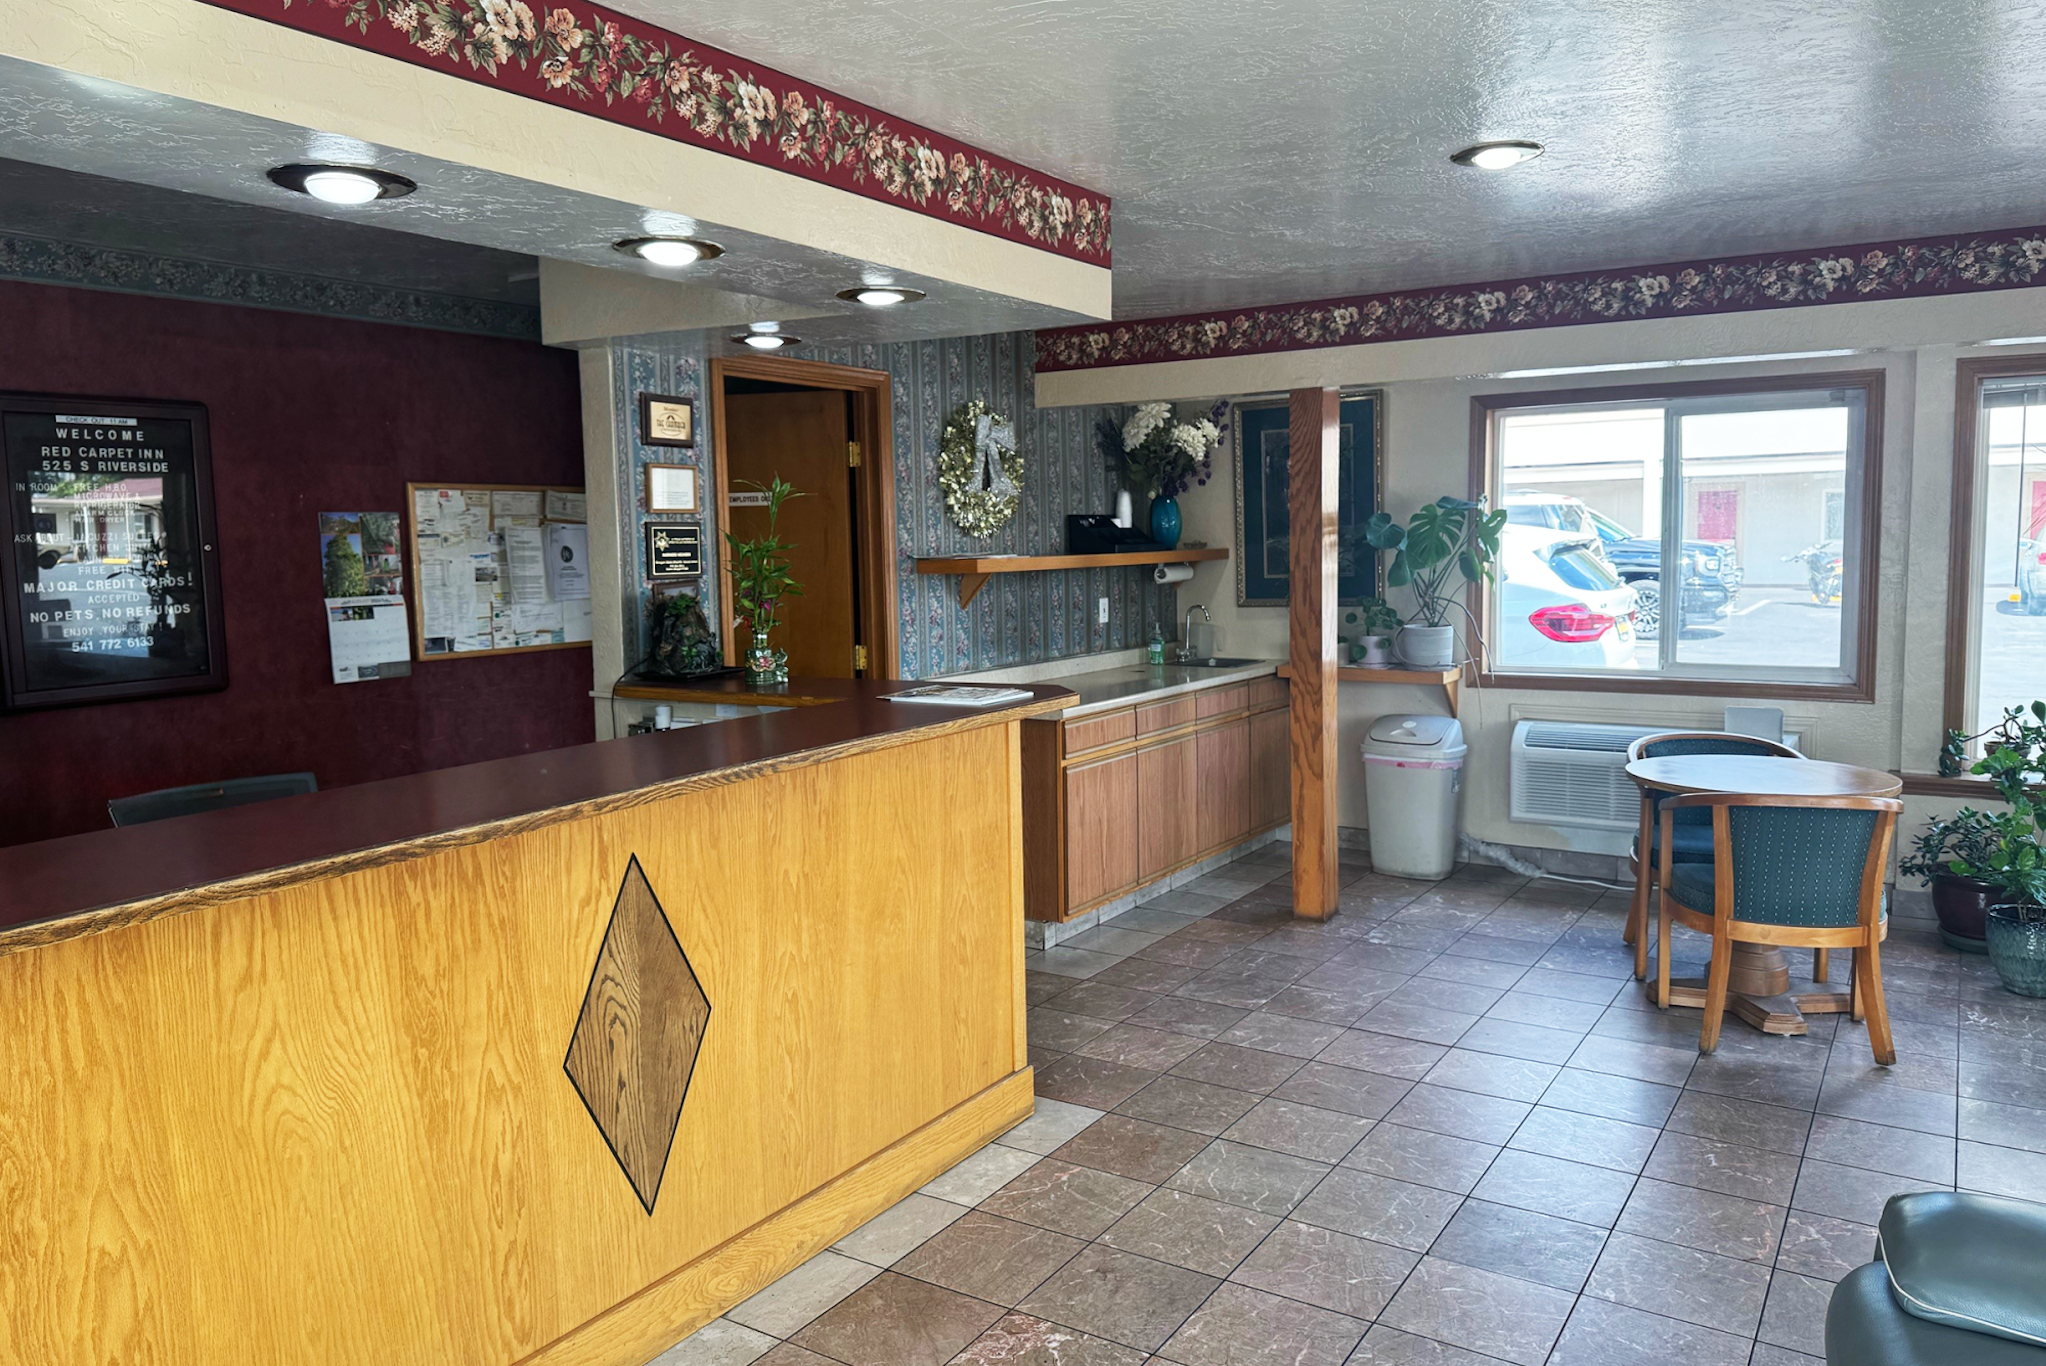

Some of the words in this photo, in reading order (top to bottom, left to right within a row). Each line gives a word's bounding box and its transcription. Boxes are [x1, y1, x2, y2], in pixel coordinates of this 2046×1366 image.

[55, 428, 144, 441] WELCOME
[41, 446, 72, 457] RED
[78, 446, 134, 458] CARPET
[138, 449, 164, 459] INN
[42, 460, 72, 471] 525
[80, 460, 89, 471] S
[98, 461, 169, 472] RIVERSIDE
[15, 482, 26, 491] IN
[30, 482, 58, 491] ROOM
[73, 483, 100, 492] FREE
[13, 534, 33, 543] ASK
[78, 566, 106, 575] FREE
[24, 581, 78, 593] MAJOR
[86, 579, 135, 590] CREDIT
[88, 594, 140, 604] ACCEPTED
[30, 612, 49, 623] NO
[102, 608, 122, 619] NO
[126, 604, 191, 617] REFUNDS
[63, 627, 94, 637] ENJOY
[102, 625, 127, 634] YOUR
[71, 641, 94, 652] 541
[100, 639, 122, 650] 772
[127, 636, 155, 647] 6133
